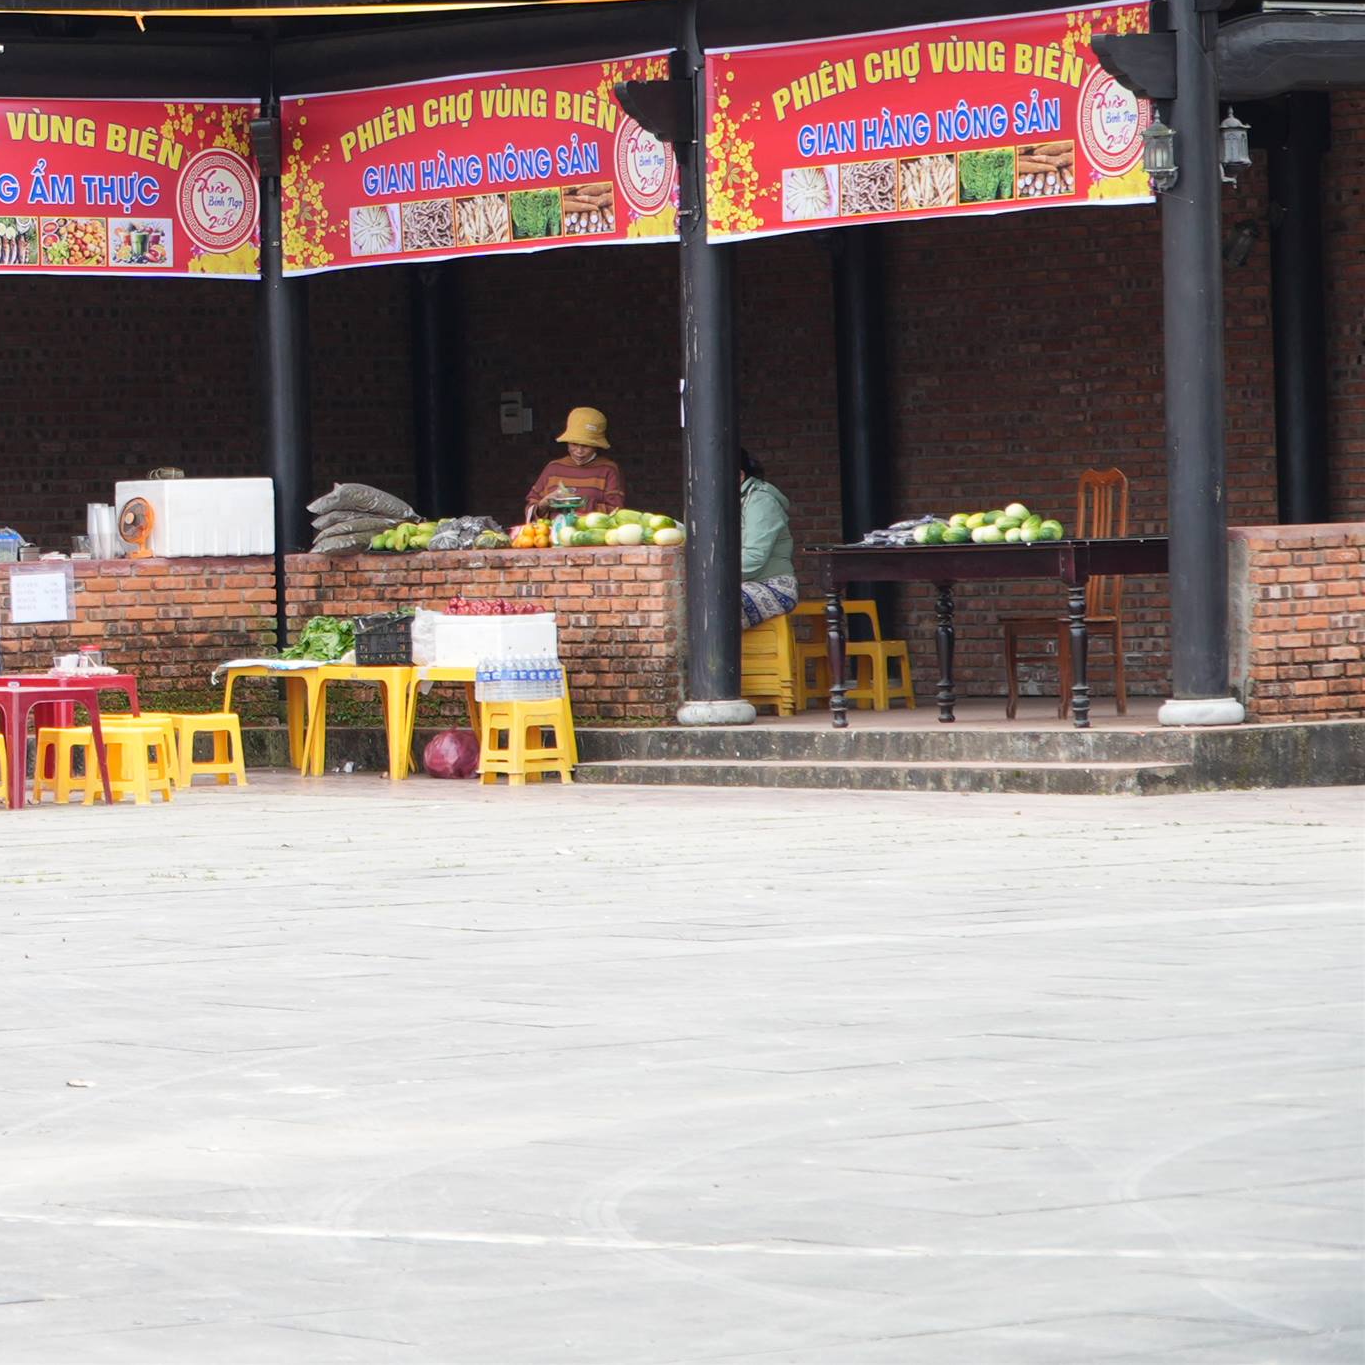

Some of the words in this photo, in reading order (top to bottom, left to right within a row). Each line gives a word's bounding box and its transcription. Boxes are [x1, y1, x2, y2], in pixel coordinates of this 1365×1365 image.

[772, 59, 857, 122] PHIÊN
[864, 41, 920, 83] CHỢ
[928, 35, 1006, 73] VÙNG
[1014, 42, 1084, 88] BIÊN
[6, 107, 96, 148] VÙNG
[106, 123, 184, 171] BIÊN
[340, 106, 416, 163] PHIÊN
[423, 90, 473, 128] CHỢ
[480, 83, 548, 119] VÙNG
[555, 90, 617, 133] BIÊN
[797, 120, 857, 157] GIAN
[862, 107, 931, 151] HÀNG
[937, 99, 1009, 143] NÔNG
[1013, 88, 1061, 135] SẢN
[28, 158, 75, 204] ẨM
[81, 171, 160, 214] THỰC
[363, 162, 416, 197] GIAN
[420, 150, 483, 191] HÀNG
[487, 142, 552, 184] NÔNG
[556, 132, 600, 177] SẢN
